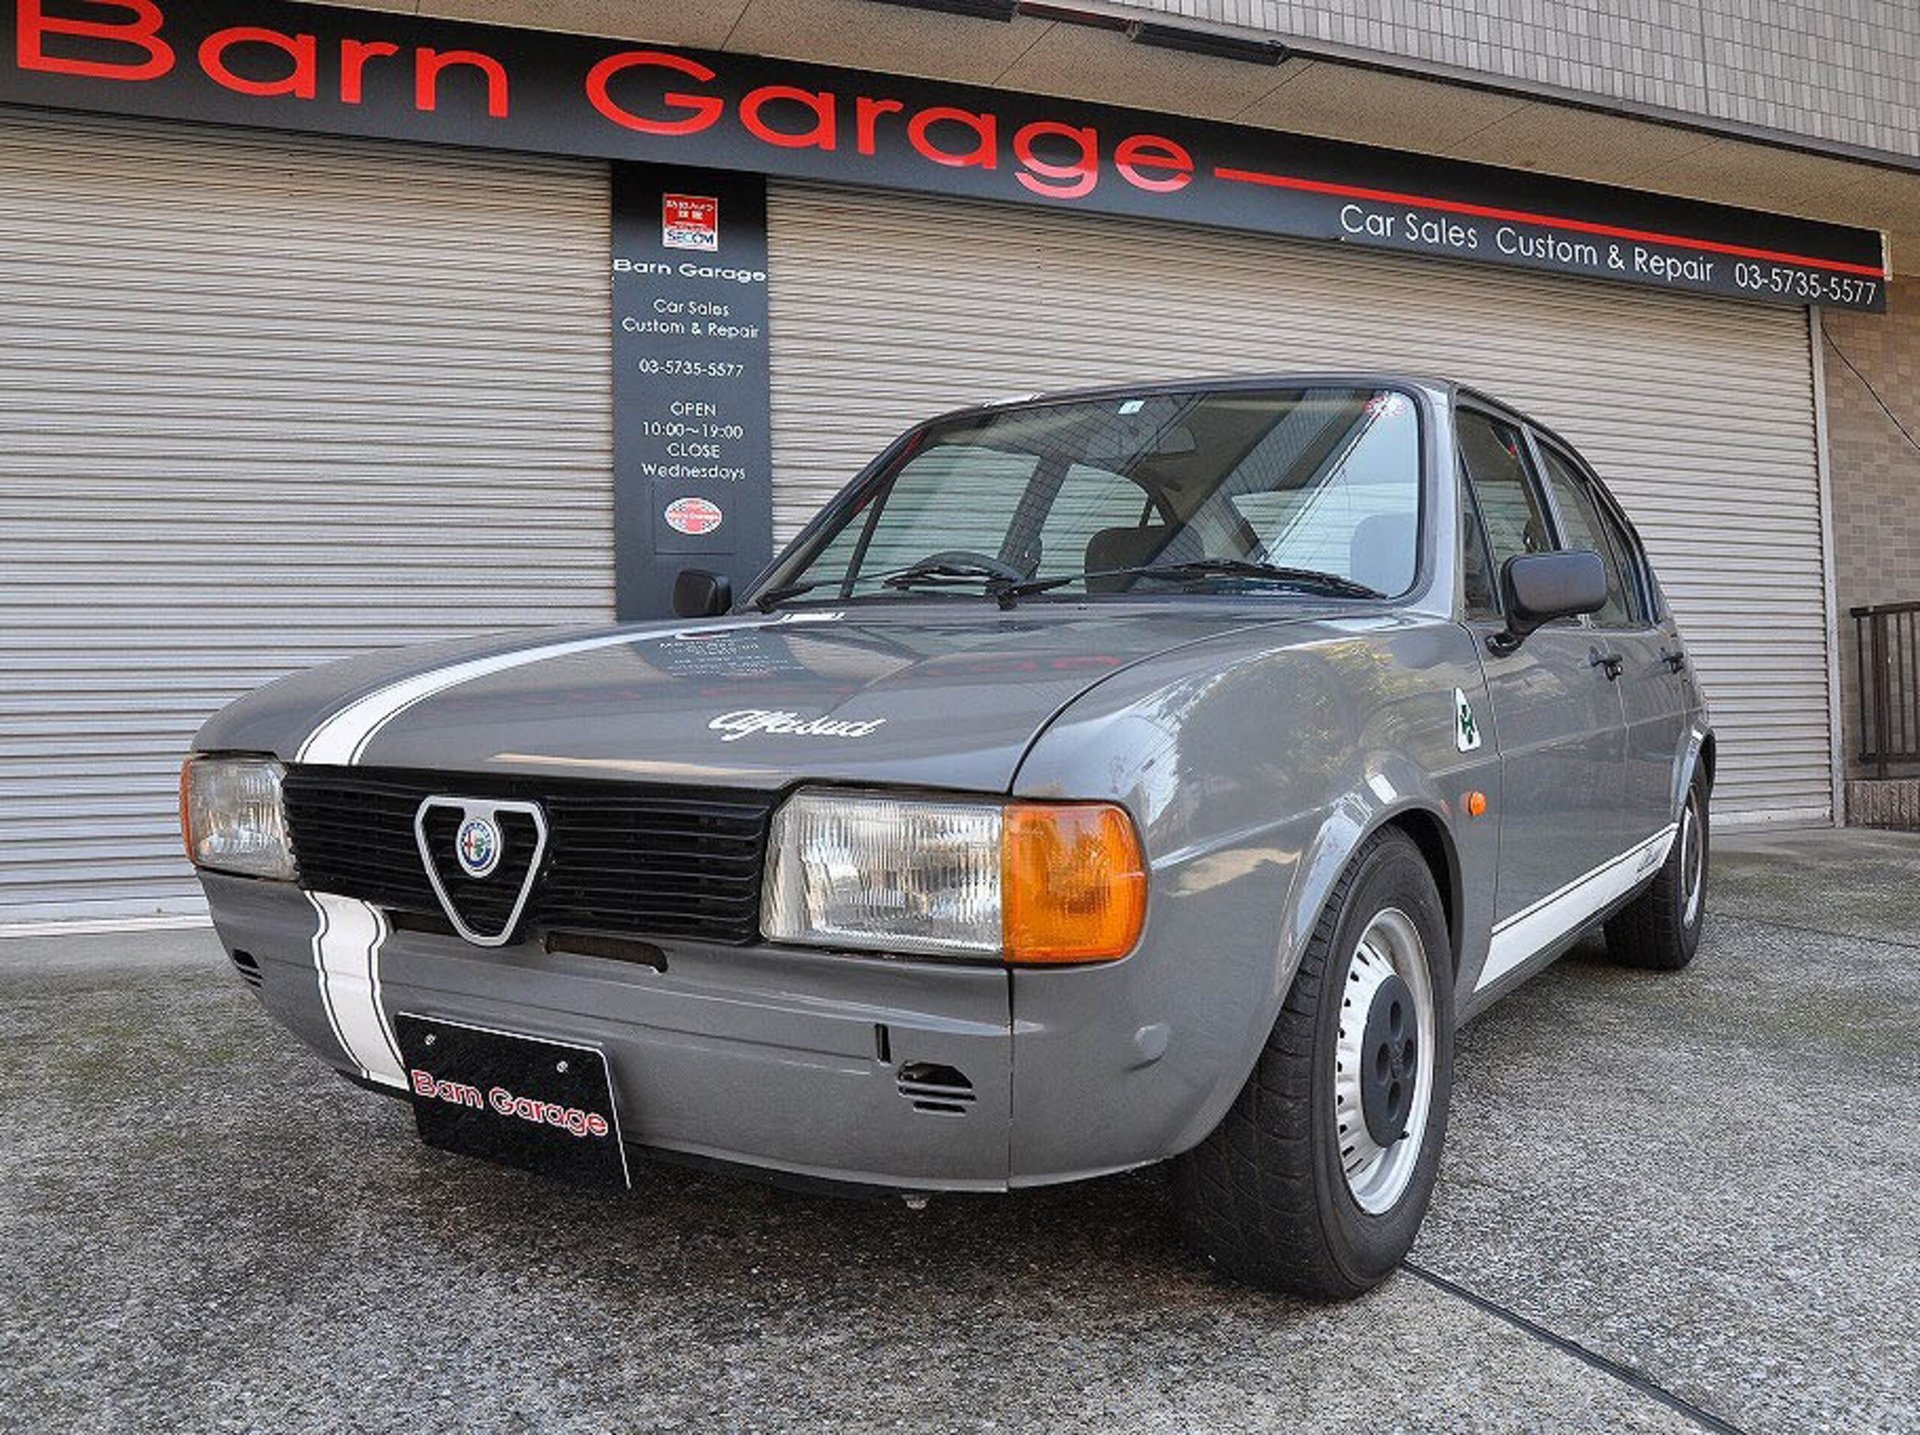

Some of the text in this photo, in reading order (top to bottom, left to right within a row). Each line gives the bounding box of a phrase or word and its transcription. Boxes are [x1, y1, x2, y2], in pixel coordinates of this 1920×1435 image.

[17, 0, 1194, 198] Barn Garage
[666, 230, 714, 245] SECOM
[1340, 205, 1714, 282] Car Sales Custom & Repair
[613, 258, 767, 284] Barn Garage
[1734, 262, 1877, 305] 03-5735-5577
[653, 298, 730, 317] Car Sales
[622, 317, 759, 339] Custom & Repair
[638, 358, 744, 377] 03-5735-5577
[670, 401, 717, 417] OPEN
[667, 443, 721, 459] CLOSE
[641, 462, 746, 482] Wednesdays
[411, 1069, 609, 1137] Barn Garage
